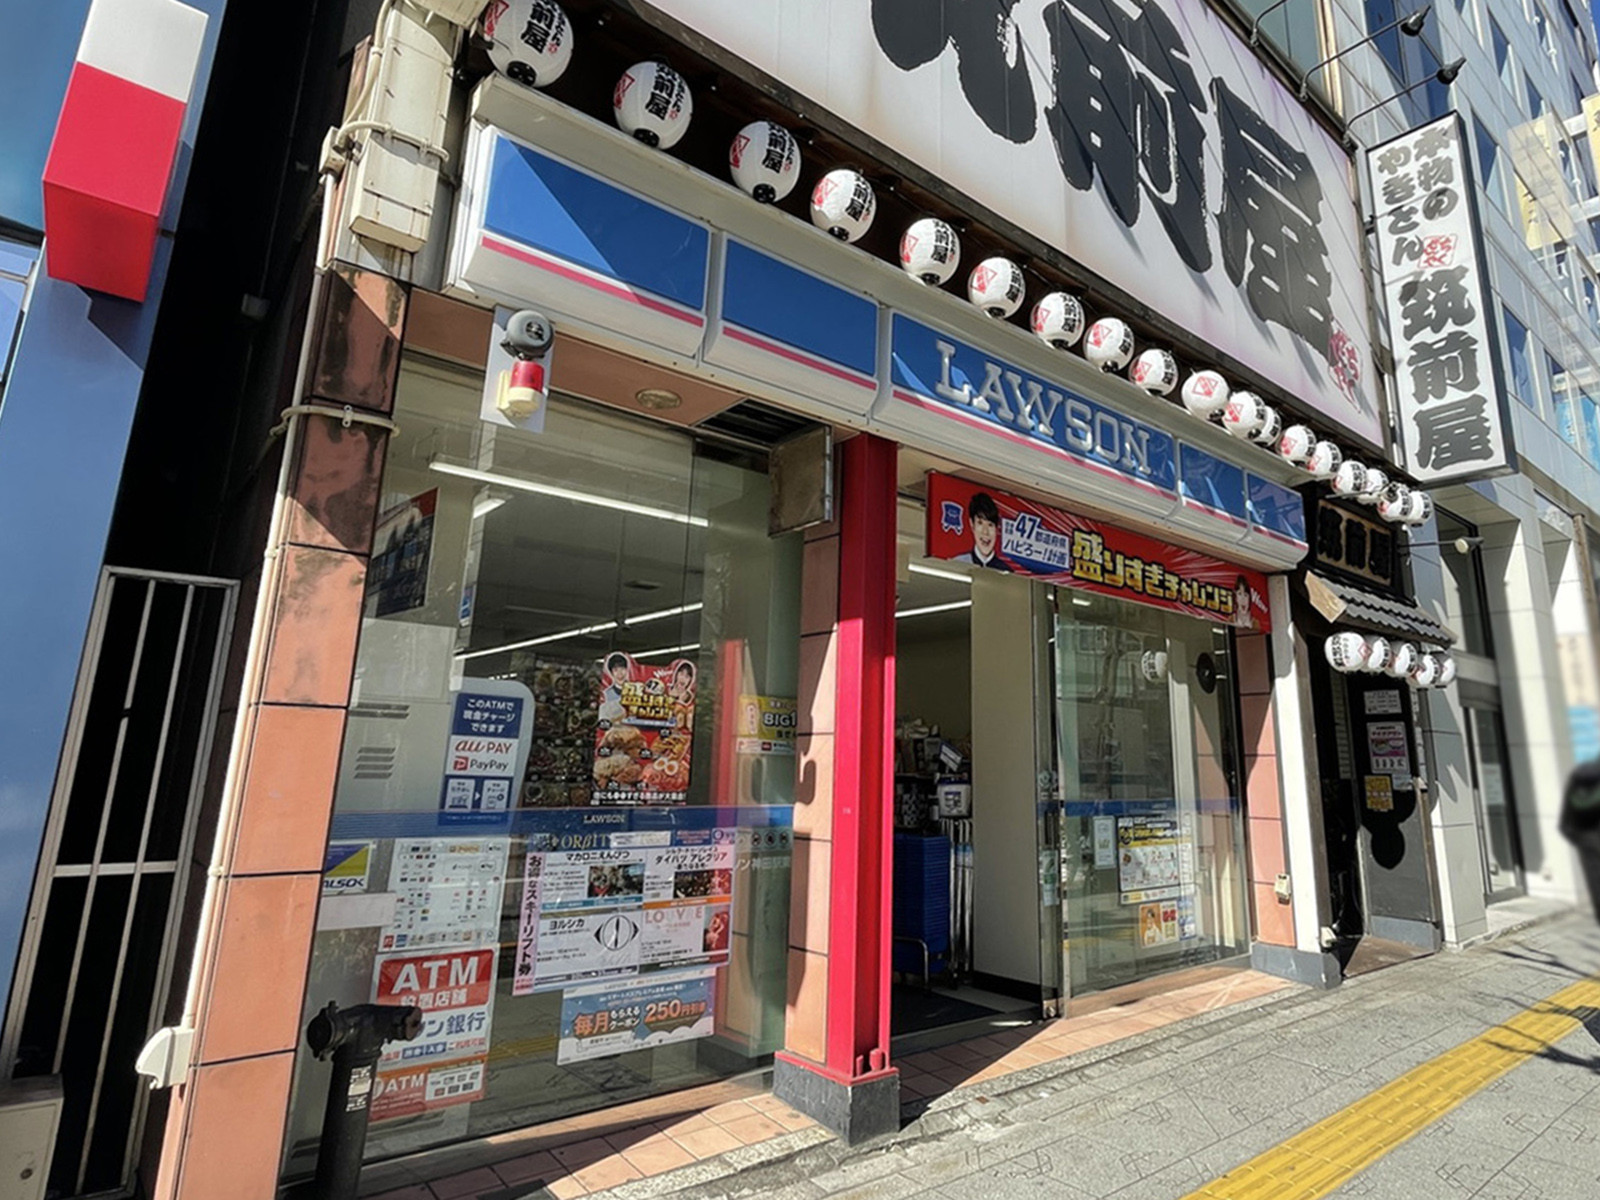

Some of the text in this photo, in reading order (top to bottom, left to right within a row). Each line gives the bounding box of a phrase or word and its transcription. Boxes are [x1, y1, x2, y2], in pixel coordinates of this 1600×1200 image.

[1399, 265, 1494, 470] 筑前屋
[935, 339, 1153, 475] LAWSON
[1072, 530, 1234, 613] 盛りすぎチャレンジ
[467, 699, 514, 711] このATMで
[455, 740, 512, 754] au PAY
[469, 759, 508, 772] PayPay
[583, 814, 625, 825] LAWSON
[549, 917, 585, 931] ヨルシカ
[391, 956, 479, 995] ATM
[610, 1006, 641, 1020] もらえる
[574, 1010, 609, 1036] 毎月
[609, 1016, 641, 1031] クーポン
[385, 1073, 425, 1093] ATM
